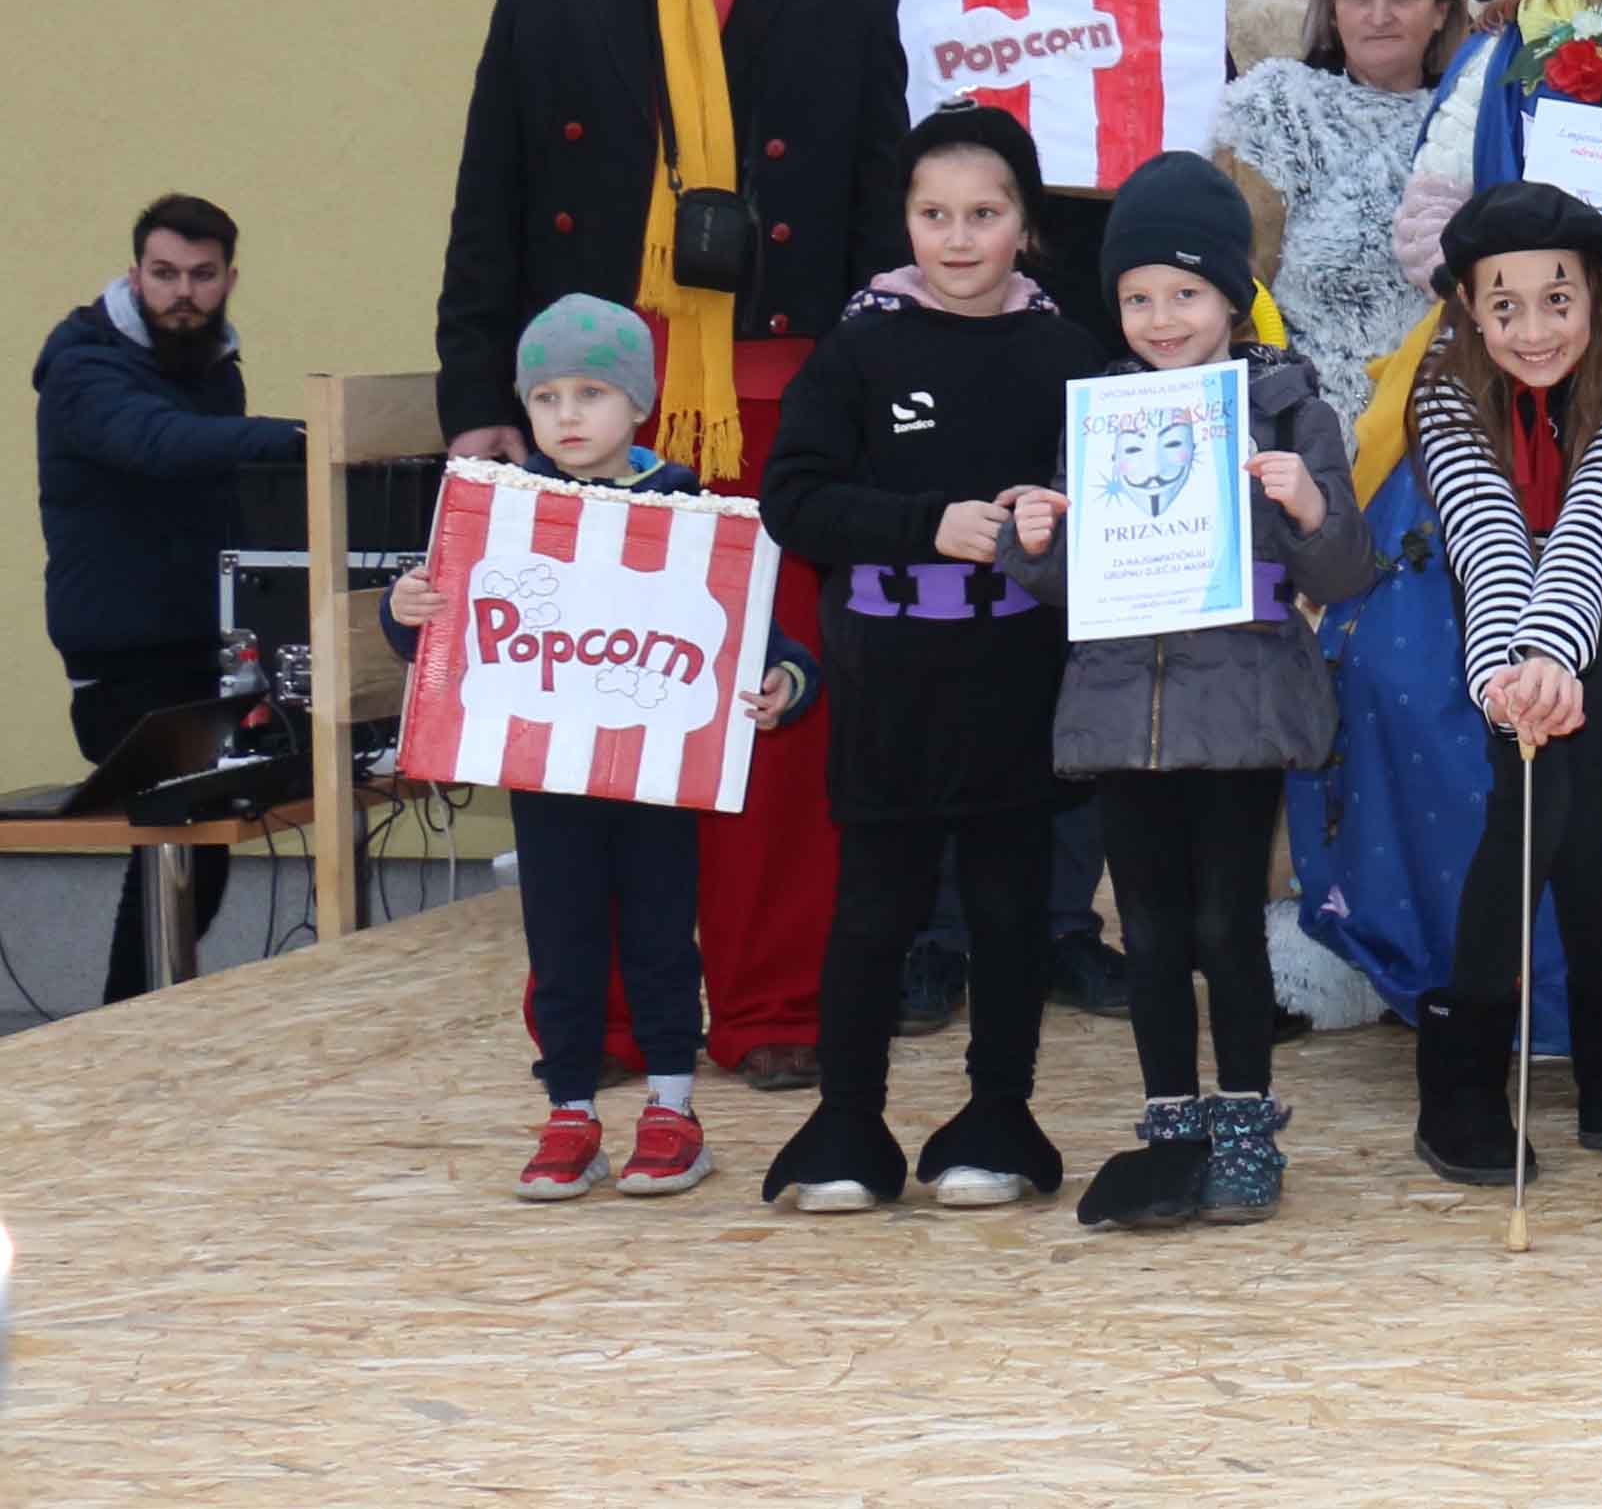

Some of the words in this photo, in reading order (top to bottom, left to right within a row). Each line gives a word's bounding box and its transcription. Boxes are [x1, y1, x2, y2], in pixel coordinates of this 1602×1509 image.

[934, 19, 1114, 80] Popcorn
[1104, 515, 1213, 544] PRIZNANJE
[472, 596, 706, 694] Popcorn
